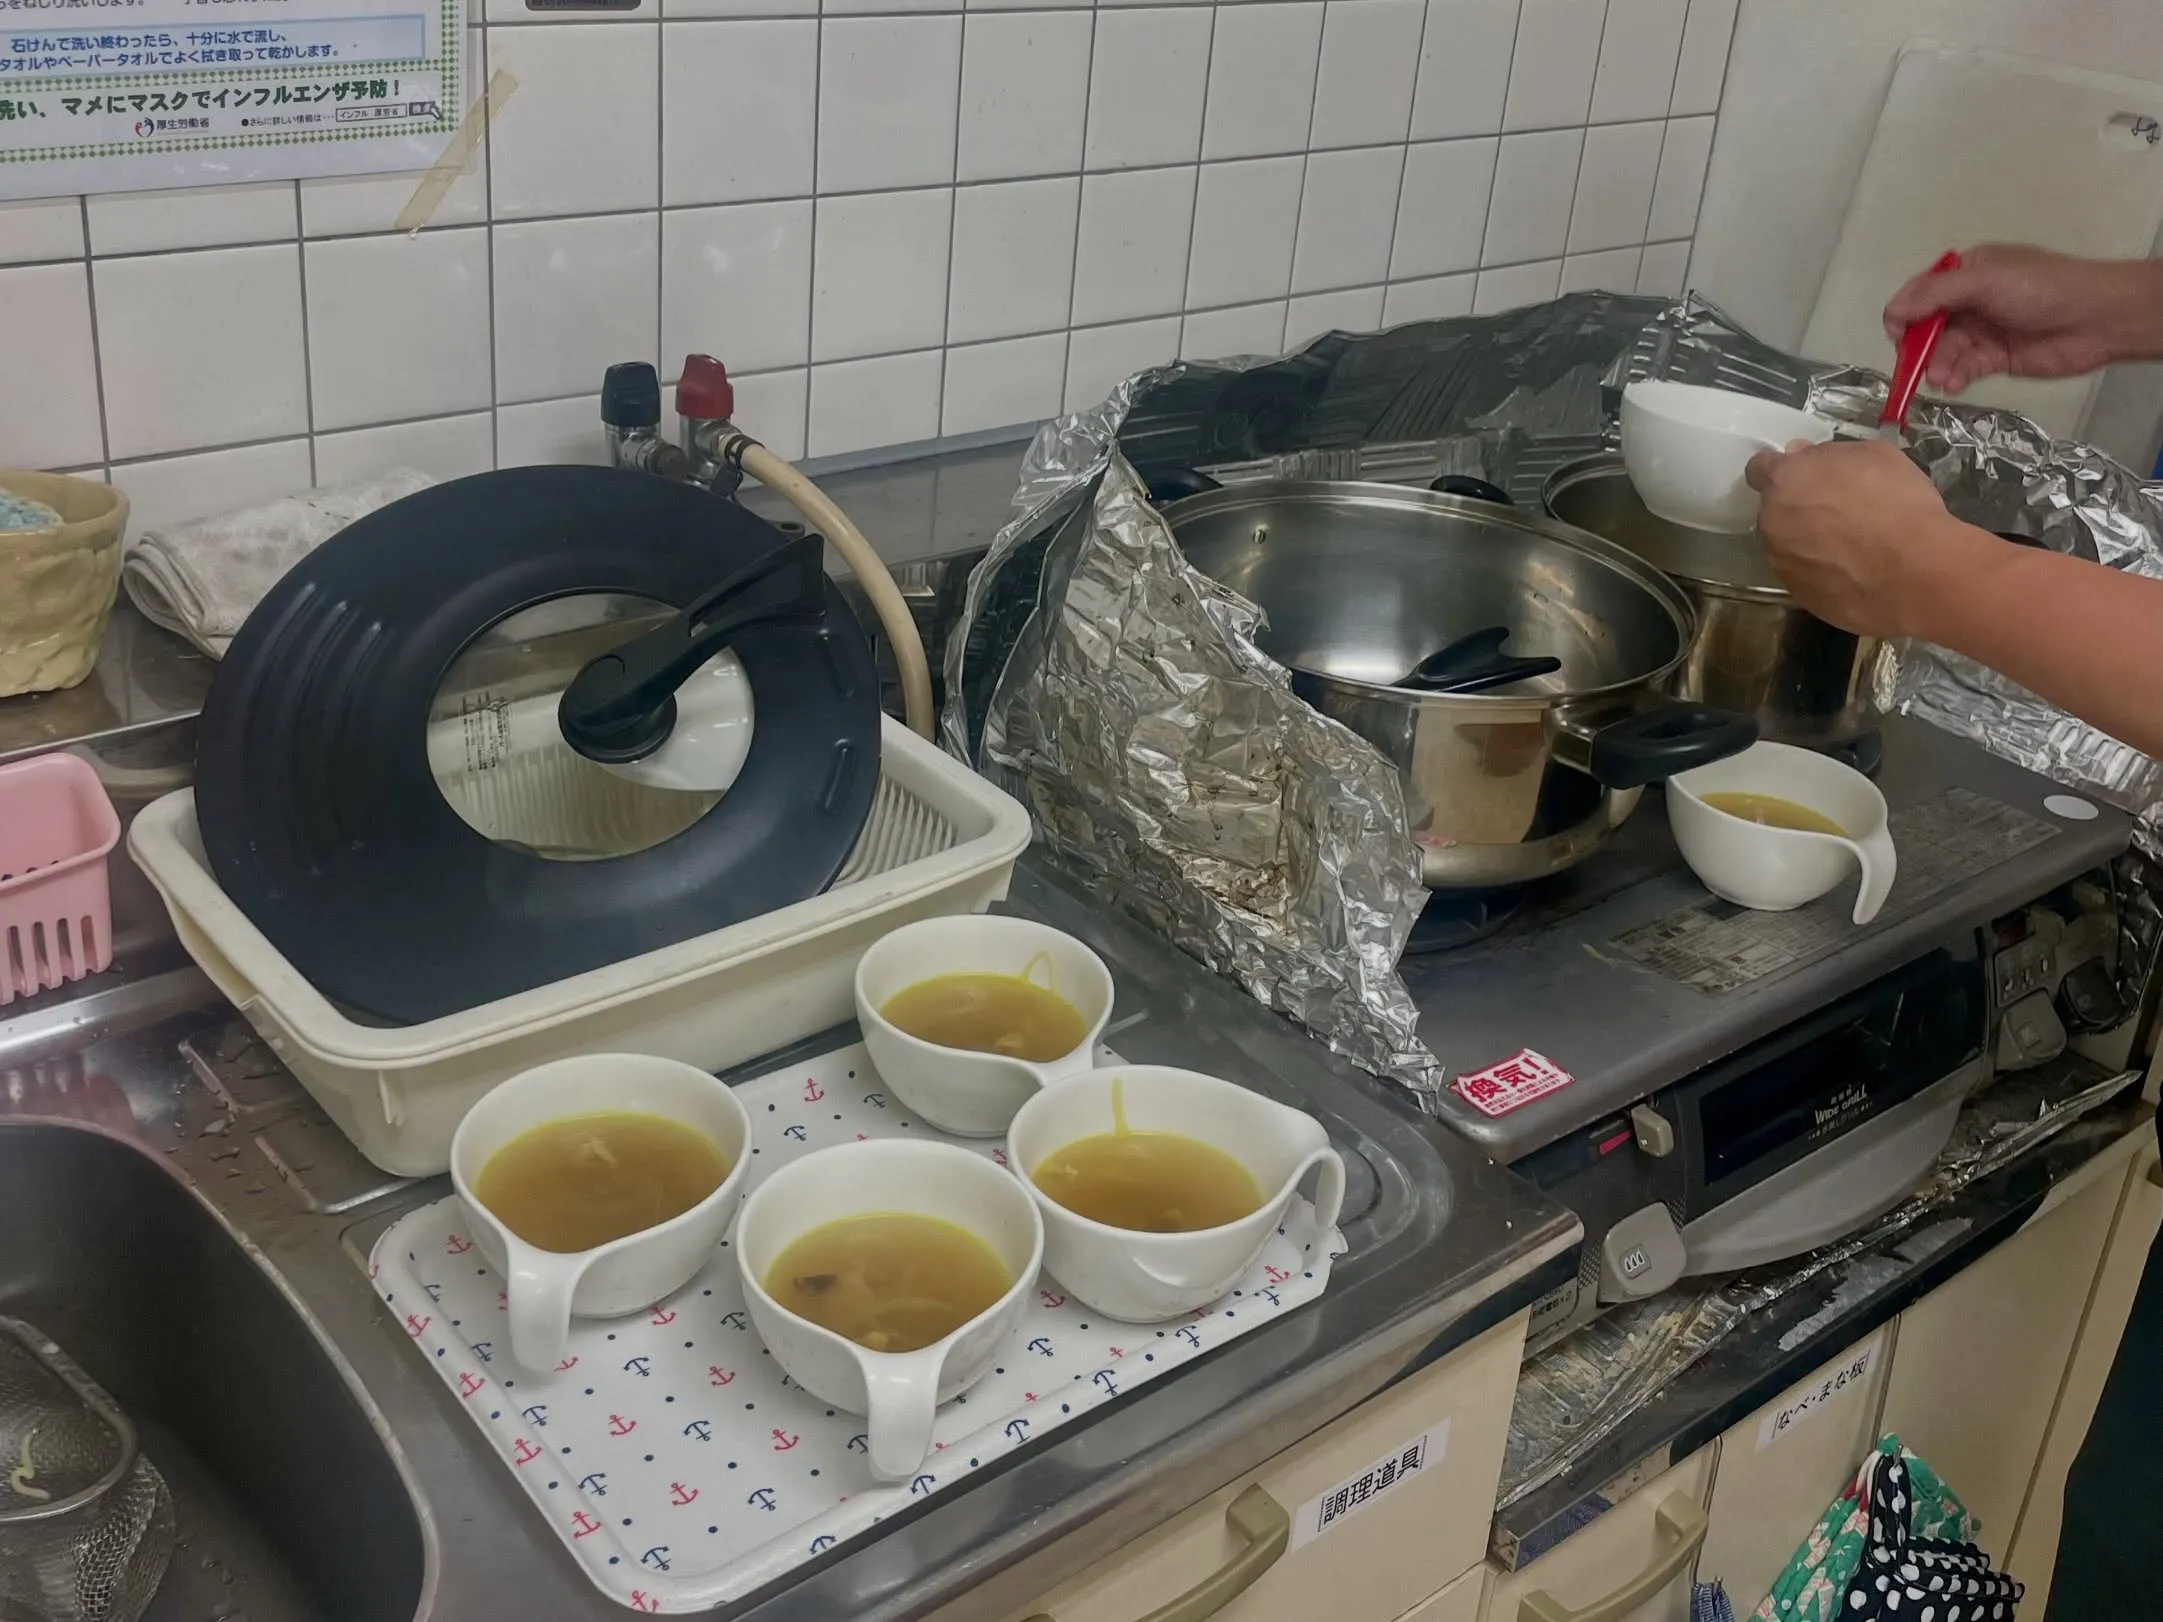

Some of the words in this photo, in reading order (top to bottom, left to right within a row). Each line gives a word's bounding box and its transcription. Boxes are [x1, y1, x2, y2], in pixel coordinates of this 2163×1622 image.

[11, 29, 287, 53] 石けんで洗い終わったら、十分に水で流し、
[156, 117, 210, 131] 厚生労働省
[1814, 1105, 1840, 1125] WIDE
[1841, 1083, 1868, 1110] GRILL
[1777, 1355, 1866, 1430] なべ・まな板
[1323, 1445, 1420, 1525] 調理道具
